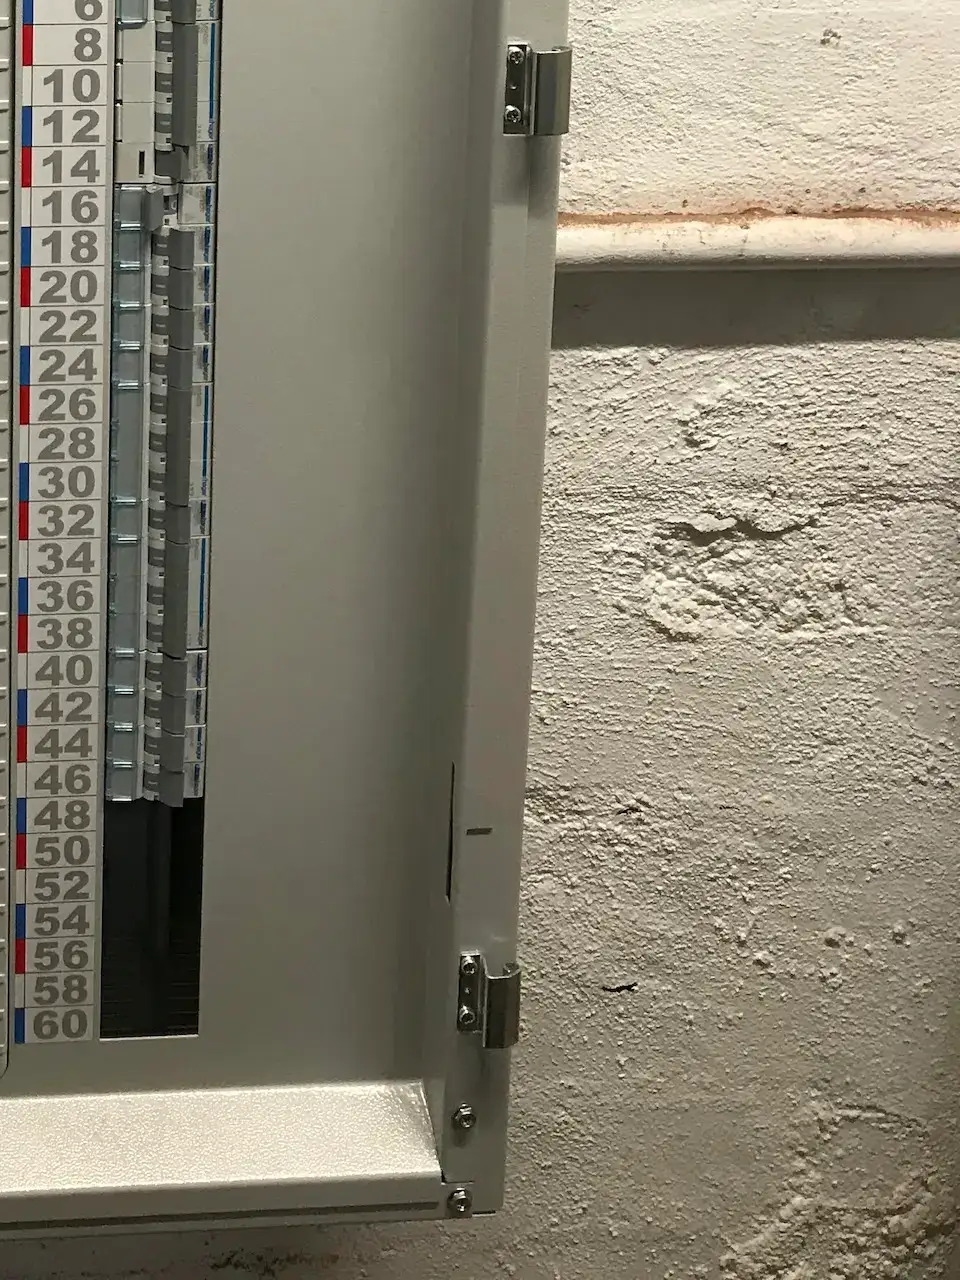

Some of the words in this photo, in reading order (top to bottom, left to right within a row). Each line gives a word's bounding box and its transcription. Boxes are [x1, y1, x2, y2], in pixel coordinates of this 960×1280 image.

[74, 28, 102, 62] 8
[44, 69, 100, 103] 10
[43, 109, 99, 143] 12
[42, 150, 100, 184] 14
[42, 190, 99, 224] 16
[42, 230, 98, 263] 18
[39, 270, 97, 304] 20
[39, 310, 97, 343] 22
[38, 348, 97, 382] 24
[38, 388, 96, 421] 26
[37, 427, 95, 460] 28
[38, 466, 95, 499] 30
[37, 504, 94, 537] 32
[37, 542, 95, 575] 34
[37, 580, 94, 612] 36
[36, 618, 93, 650] 38
[35, 654, 92, 686] 40
[35, 691, 92, 722] 42
[35, 728, 92, 759] 44
[35, 764, 91, 795] 46
[35, 800, 90, 831] 48
[35, 836, 90, 866] 50
[35, 871, 89, 901] 52
[35, 905, 89, 936] 54
[34, 941, 89, 971] 56
[34, 975, 88, 1006] 58
[34, 1009, 87, 1039] 60
